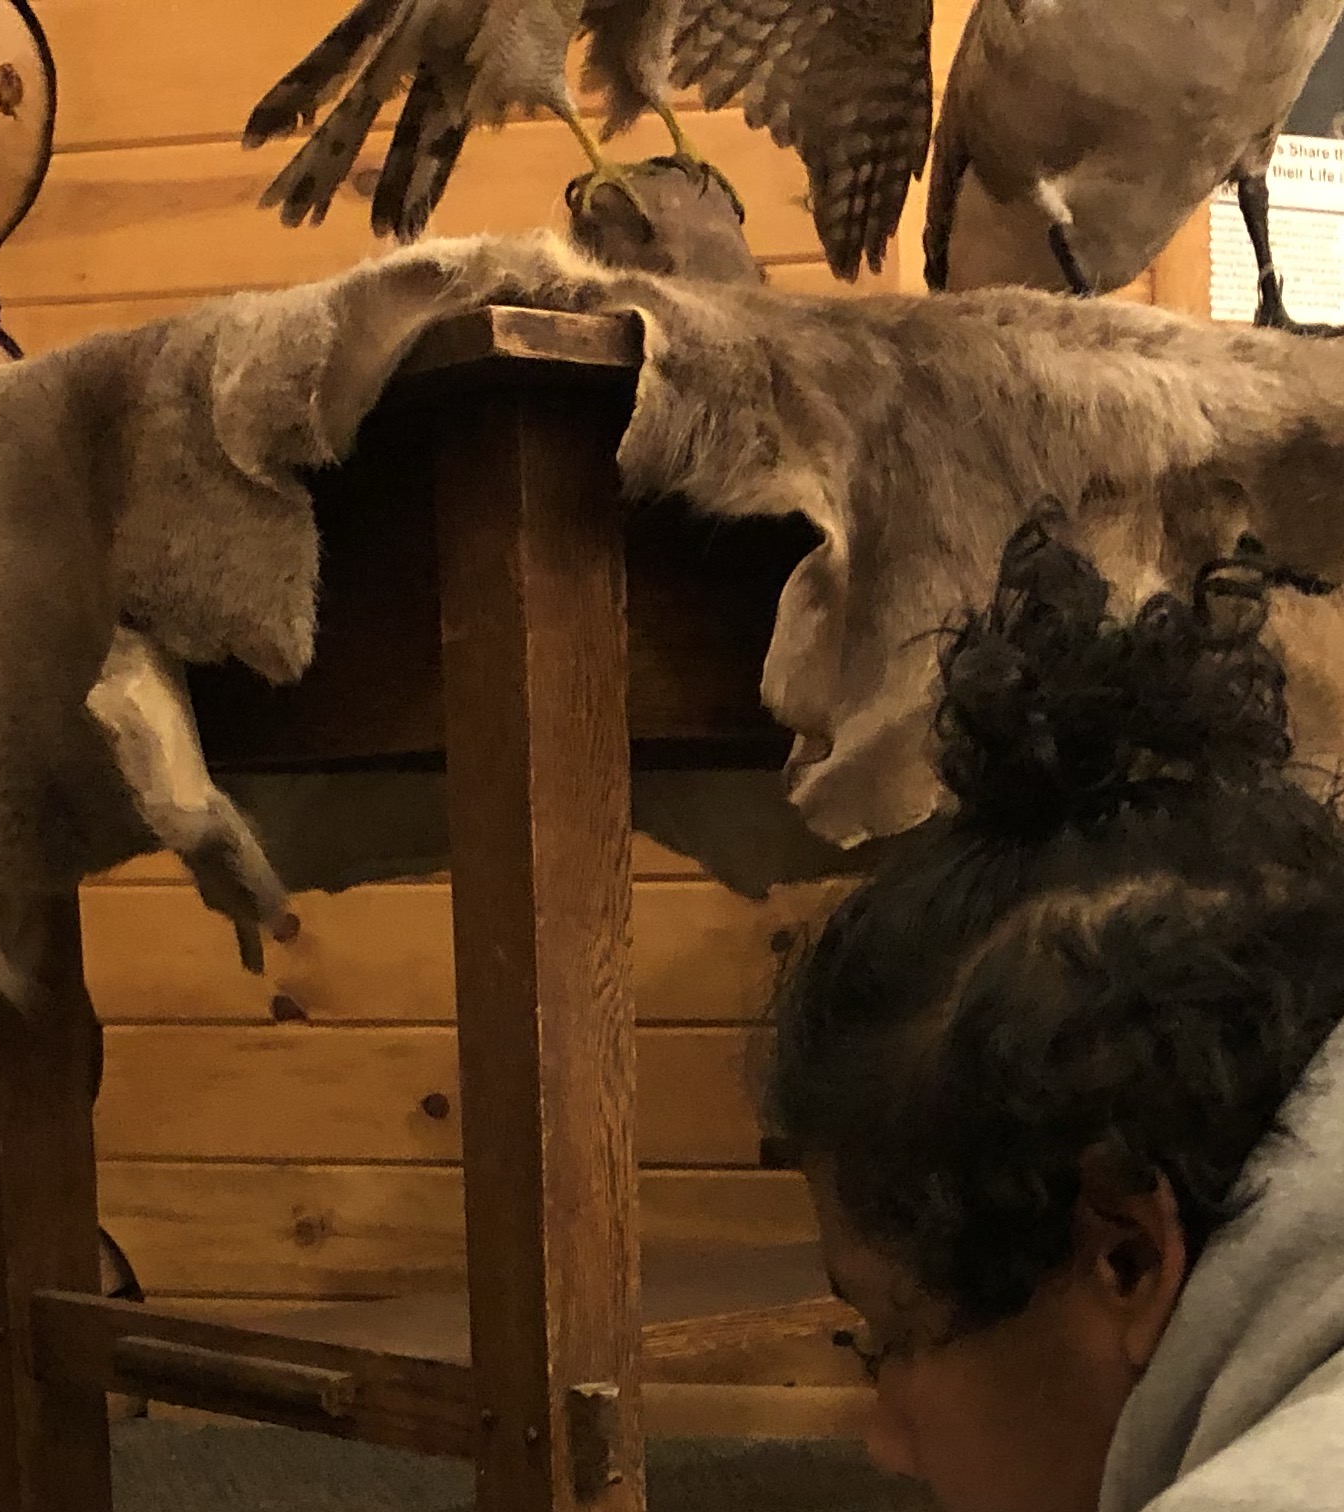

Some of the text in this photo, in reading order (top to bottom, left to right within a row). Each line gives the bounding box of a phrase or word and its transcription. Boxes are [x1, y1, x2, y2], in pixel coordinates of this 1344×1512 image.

[1289, 142, 1330, 160] Share
[1273, 165, 1304, 180] their
[1309, 167, 1336, 183] Life
